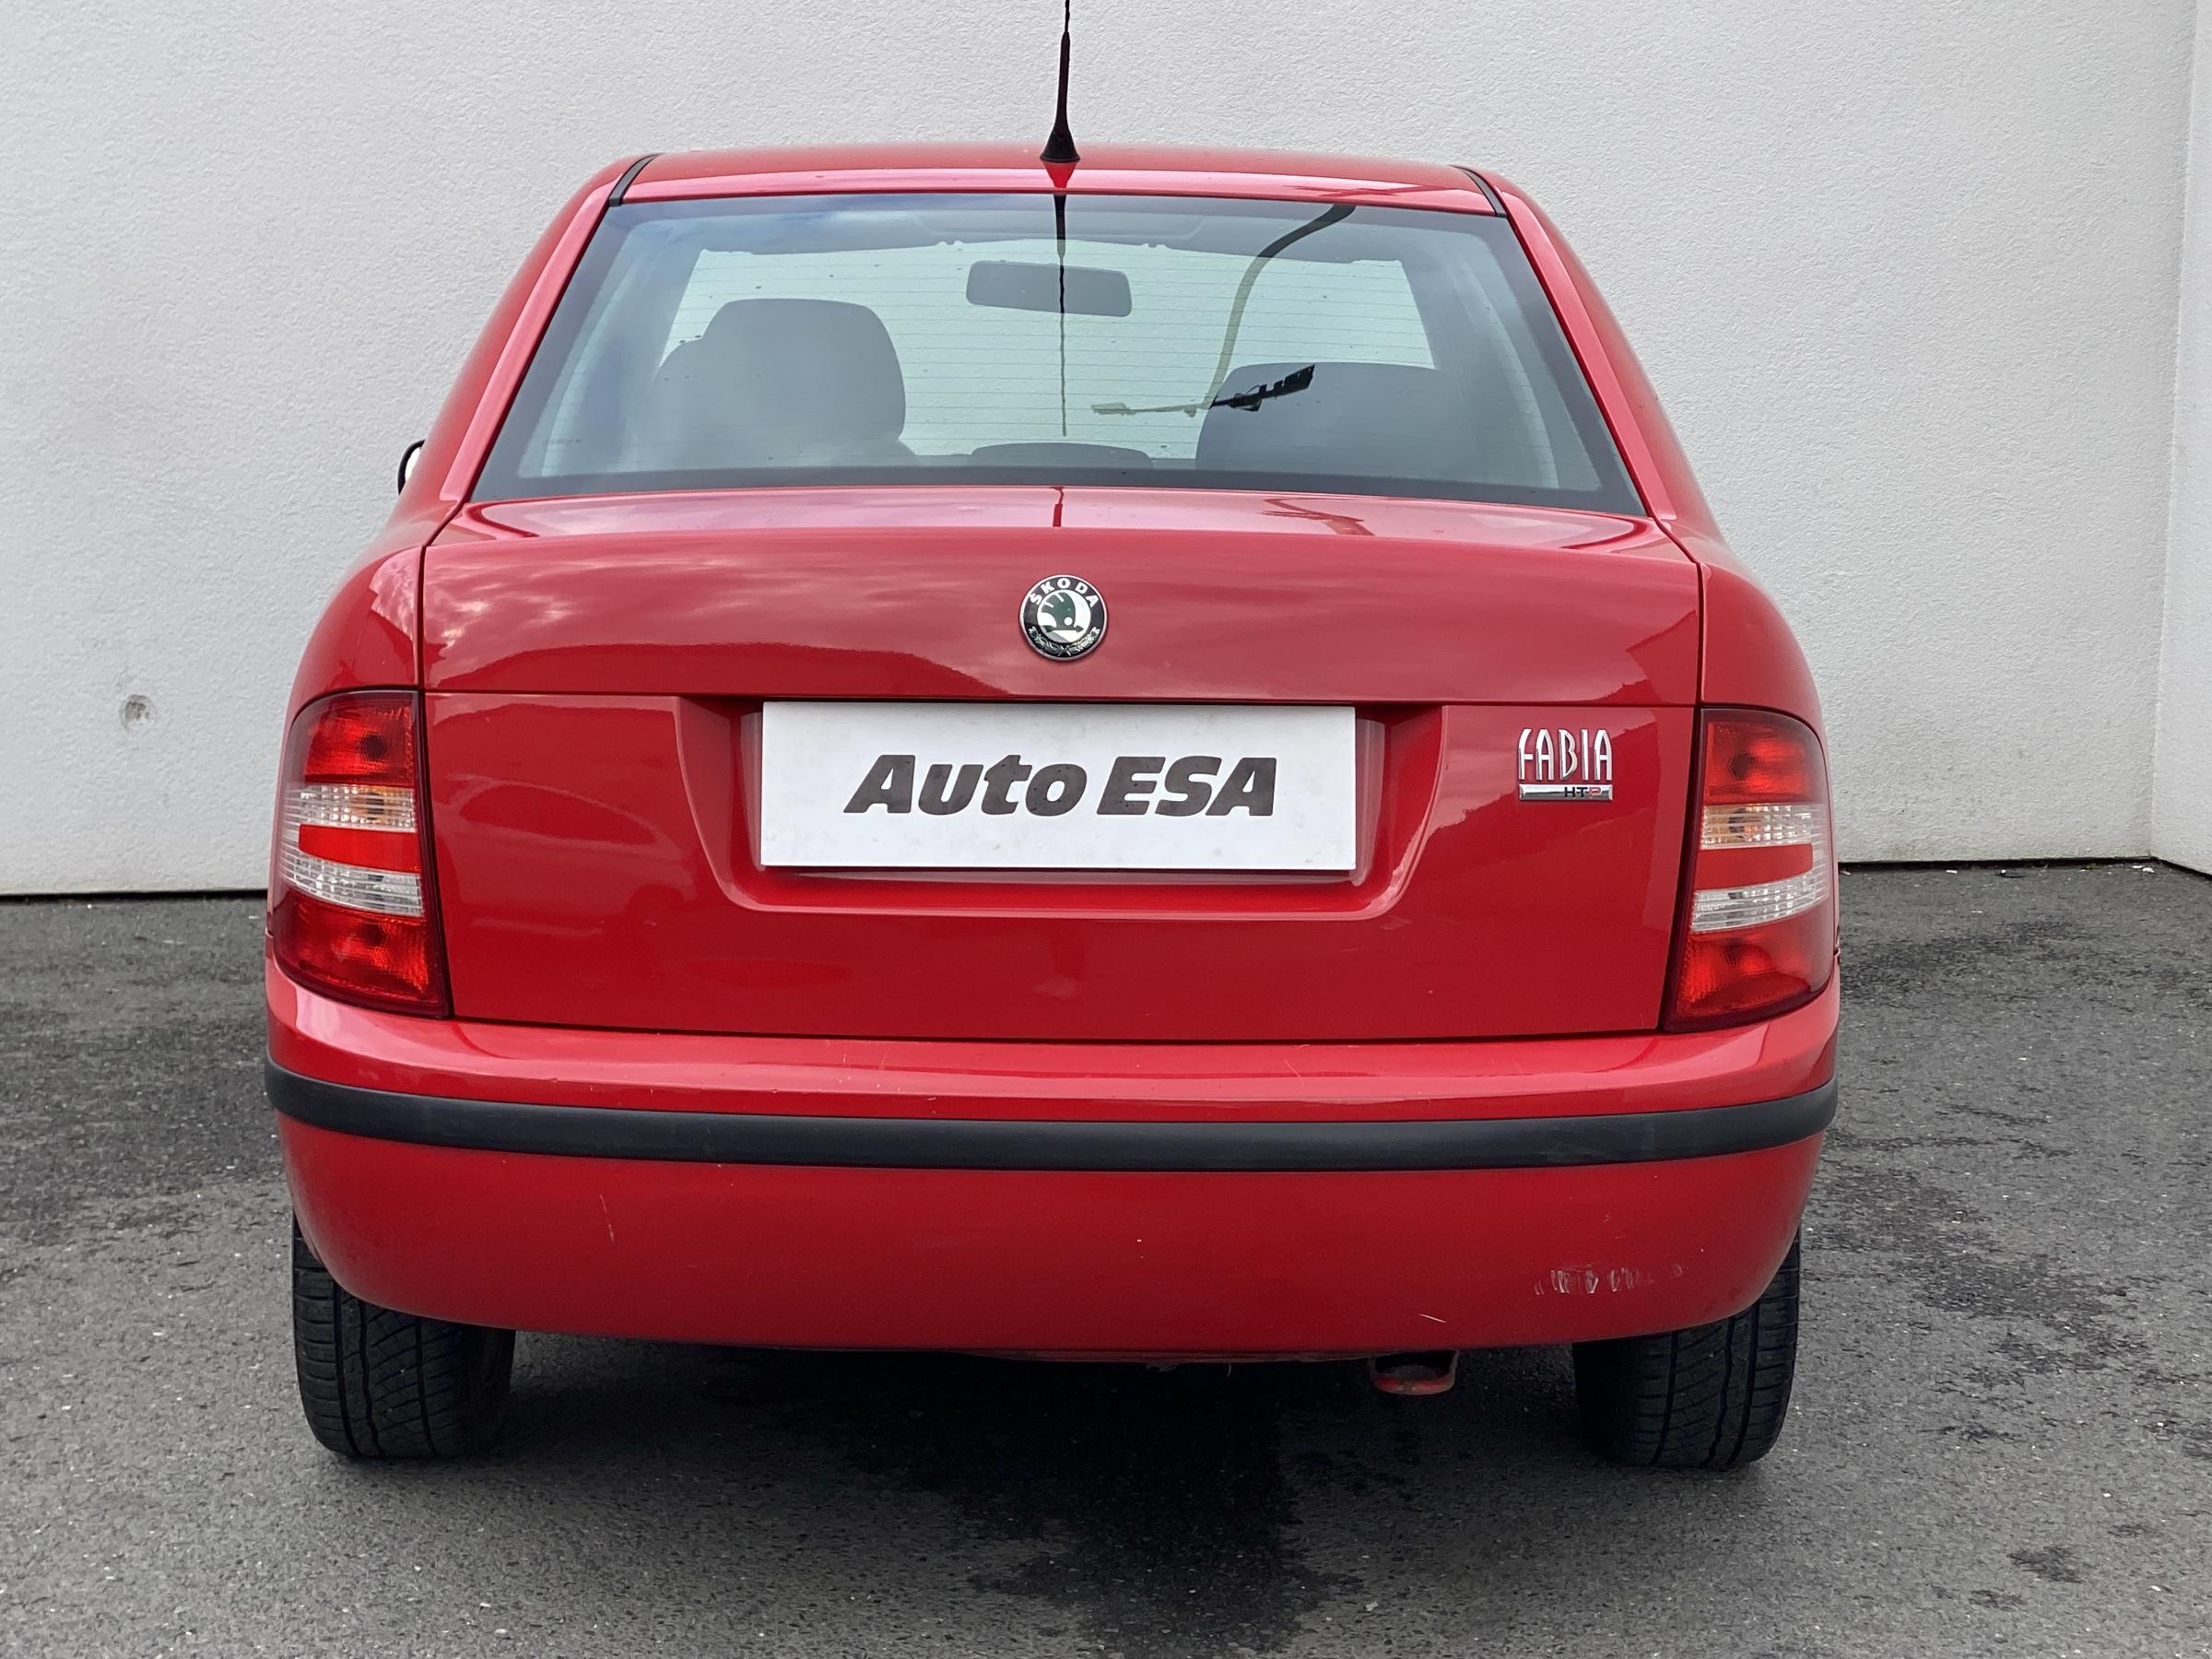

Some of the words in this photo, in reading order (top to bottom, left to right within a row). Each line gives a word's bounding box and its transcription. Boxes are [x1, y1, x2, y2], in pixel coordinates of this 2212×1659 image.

[1518, 728, 1613, 781] FABIA
[842, 754, 1088, 817] Auto
[1097, 755, 1277, 817] ESA
